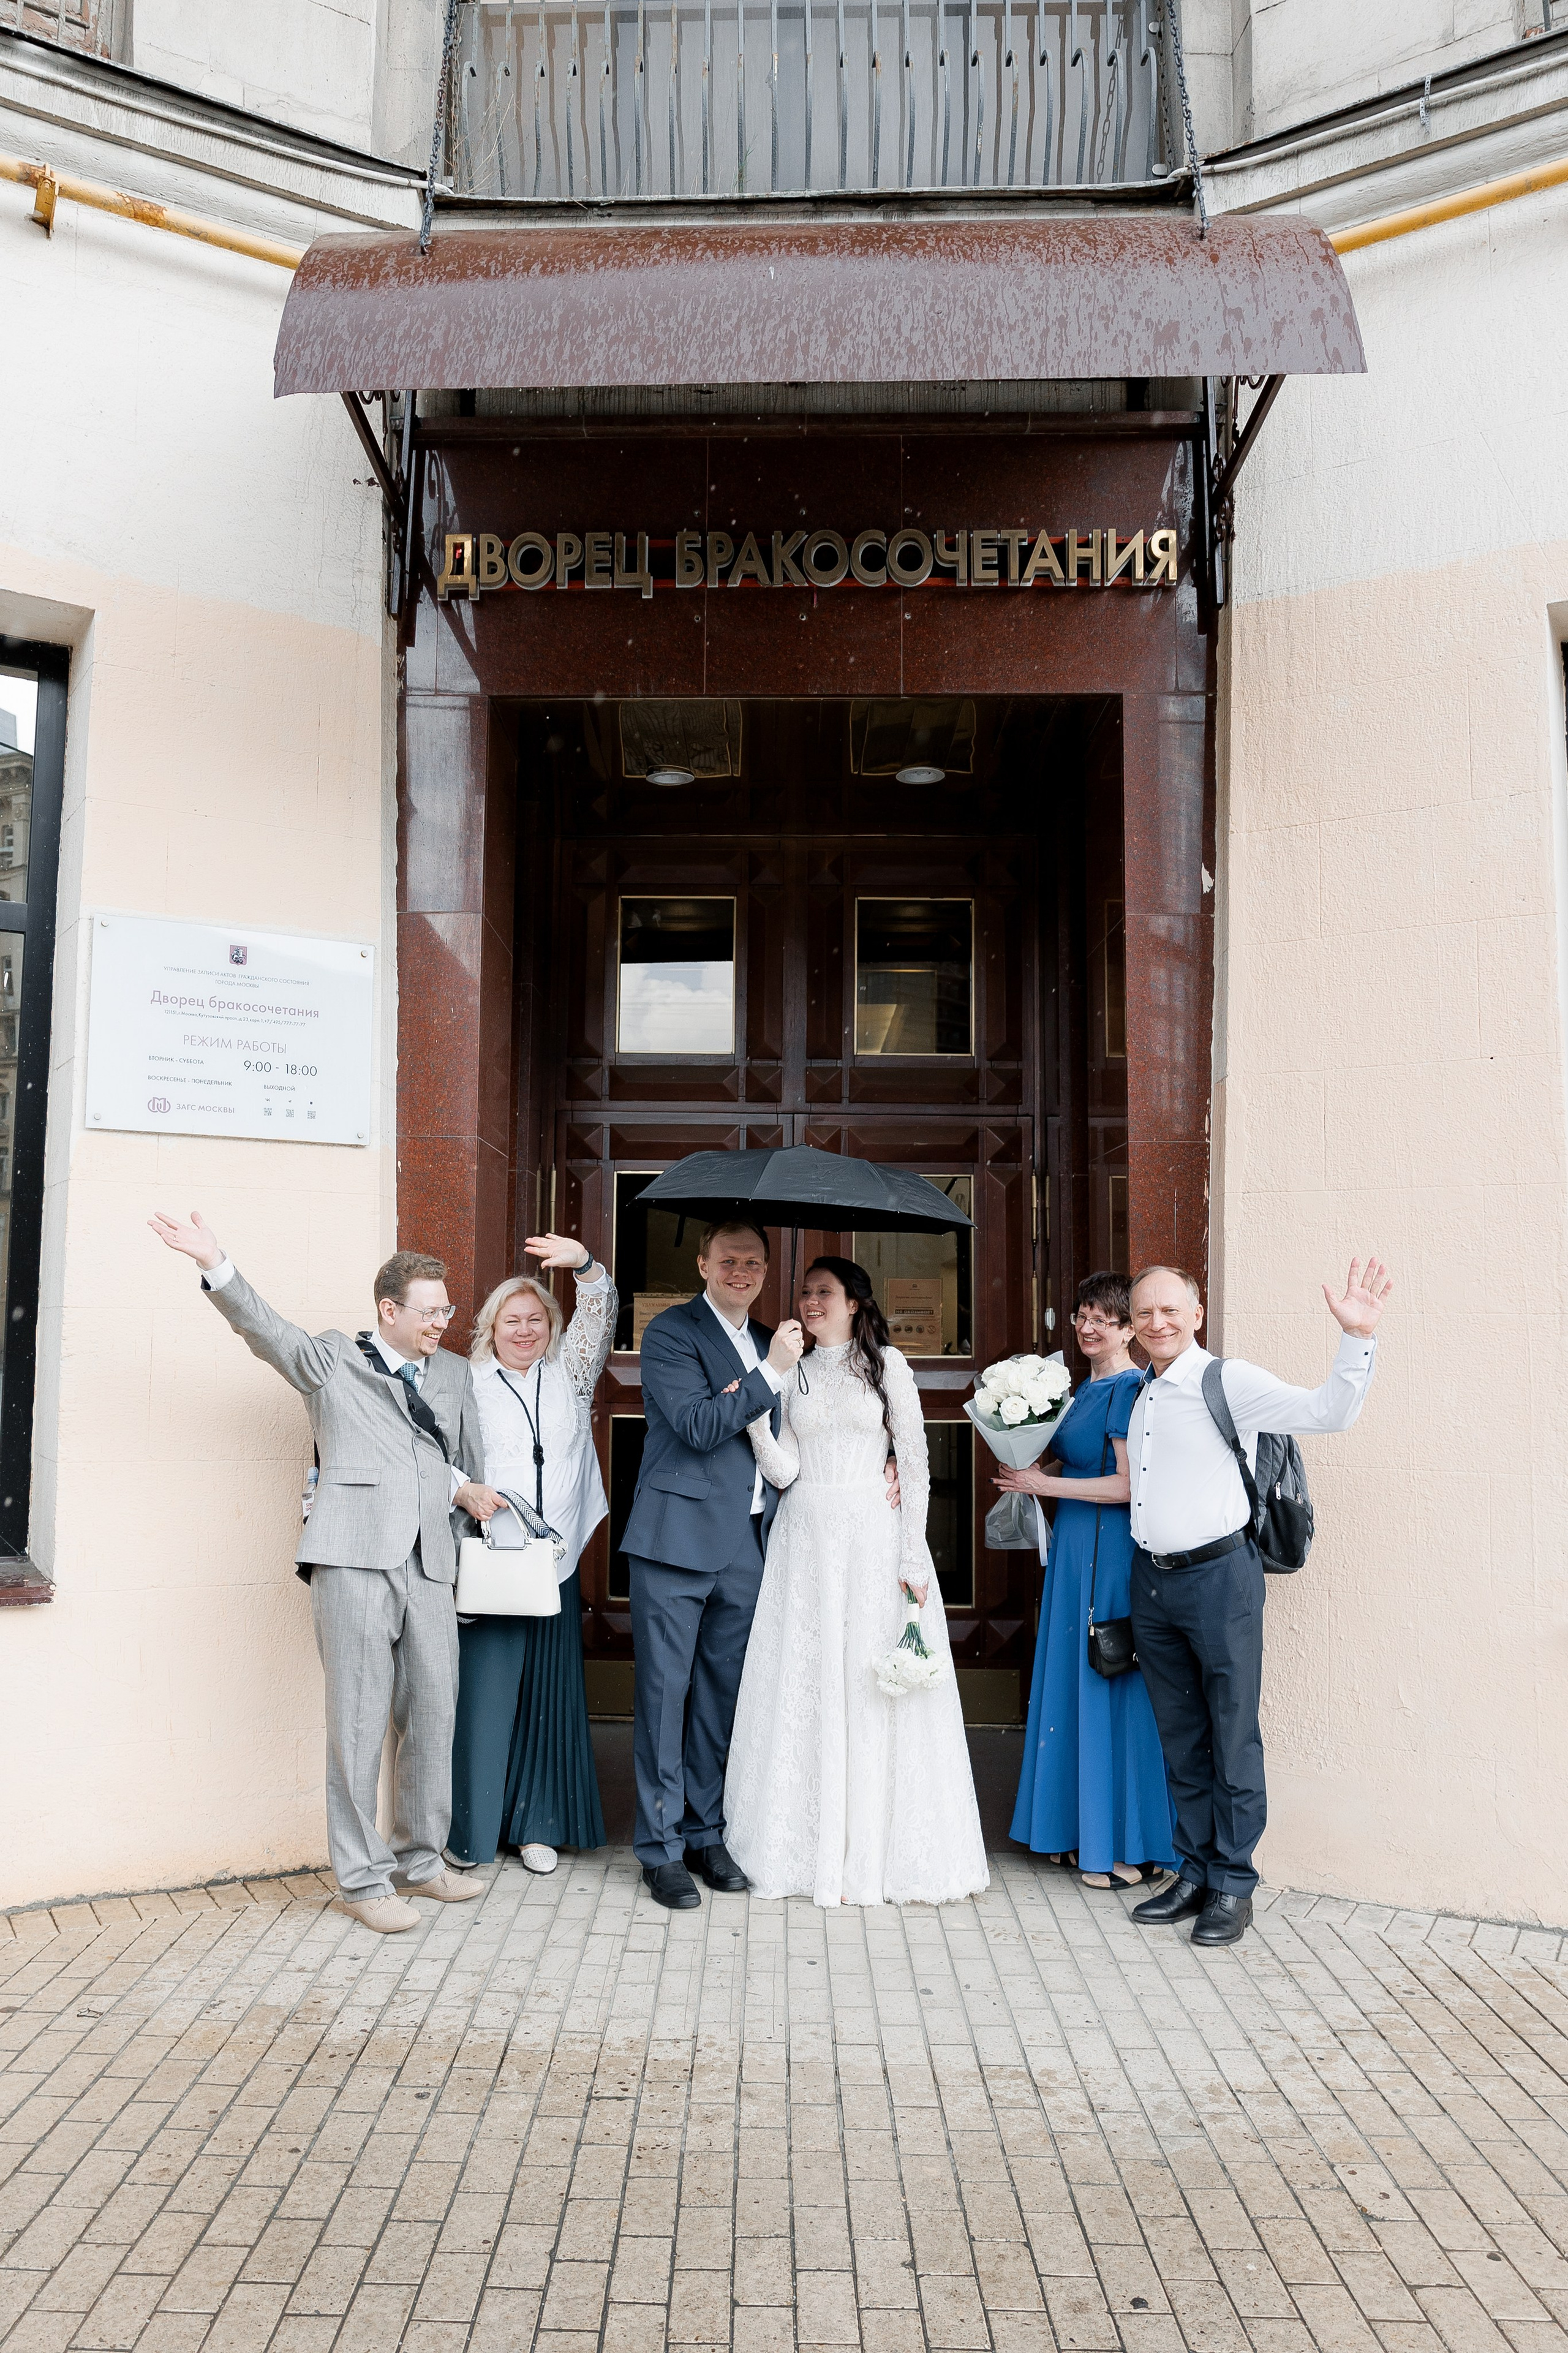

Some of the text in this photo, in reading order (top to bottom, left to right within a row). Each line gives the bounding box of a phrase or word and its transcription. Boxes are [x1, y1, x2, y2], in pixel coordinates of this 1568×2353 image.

[437, 528, 1177, 600] ДВОРЕЦ БРАКОСОЧЕТАНИЯ
[238, 974, 278, 983] ГРАЖДАНСКОГО
[150, 990, 320, 1018] Дворец бракосочетания
[183, 1035, 287, 1054] РЕЖИМ РАБОТЫ
[244, 1060, 271, 1073] 9:00
[285, 1063, 317, 1076] 18:00
